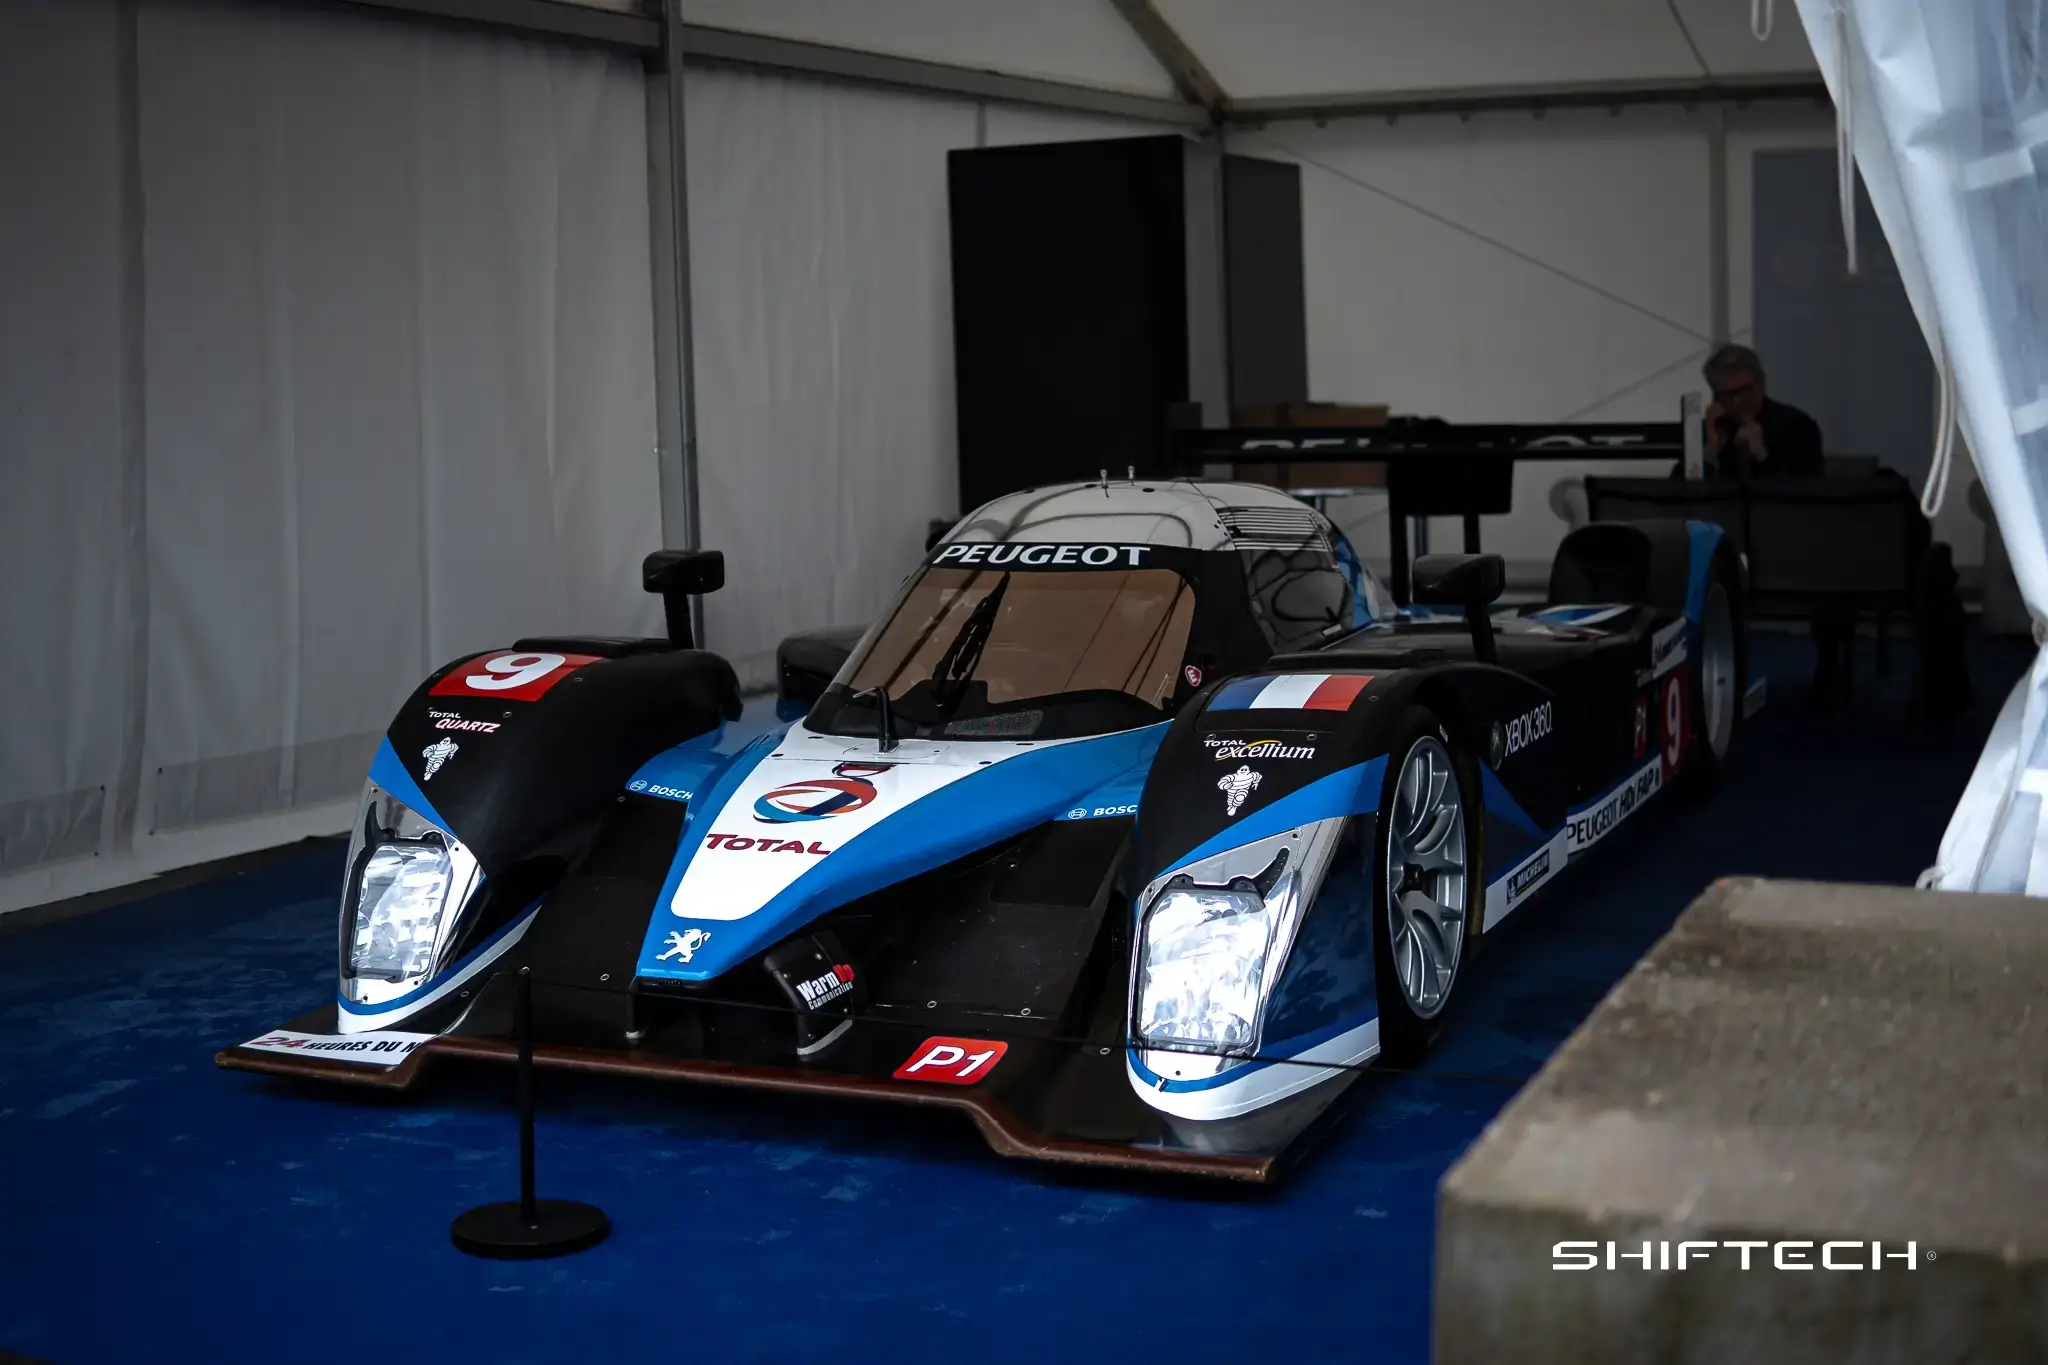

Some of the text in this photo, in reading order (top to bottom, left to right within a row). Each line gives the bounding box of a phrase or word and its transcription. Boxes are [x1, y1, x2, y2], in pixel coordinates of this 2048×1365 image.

[932, 545, 1150, 566] PEUGEOT
[465, 652, 566, 691] 9
[429, 711, 461, 719] TOTAL
[435, 718, 501, 733] QUARTZ
[1666, 677, 1681, 768] 9
[1203, 739, 1247, 747] TOTAL
[1215, 742, 1315, 760] excellium
[648, 784, 694, 800] BOSCH
[1093, 804, 1138, 816] BOSC
[1566, 798, 1619, 845] PEUGEOT
[706, 833, 832, 855] TOTAL
[1516, 852, 1549, 890] MICHELIN
[807, 981, 854, 1011] Communication
[250, 1036, 311, 1049] 24
[302, 1041, 371, 1051] HEURES
[370, 1040, 403, 1052] DU
[905, 1044, 996, 1077] P1
